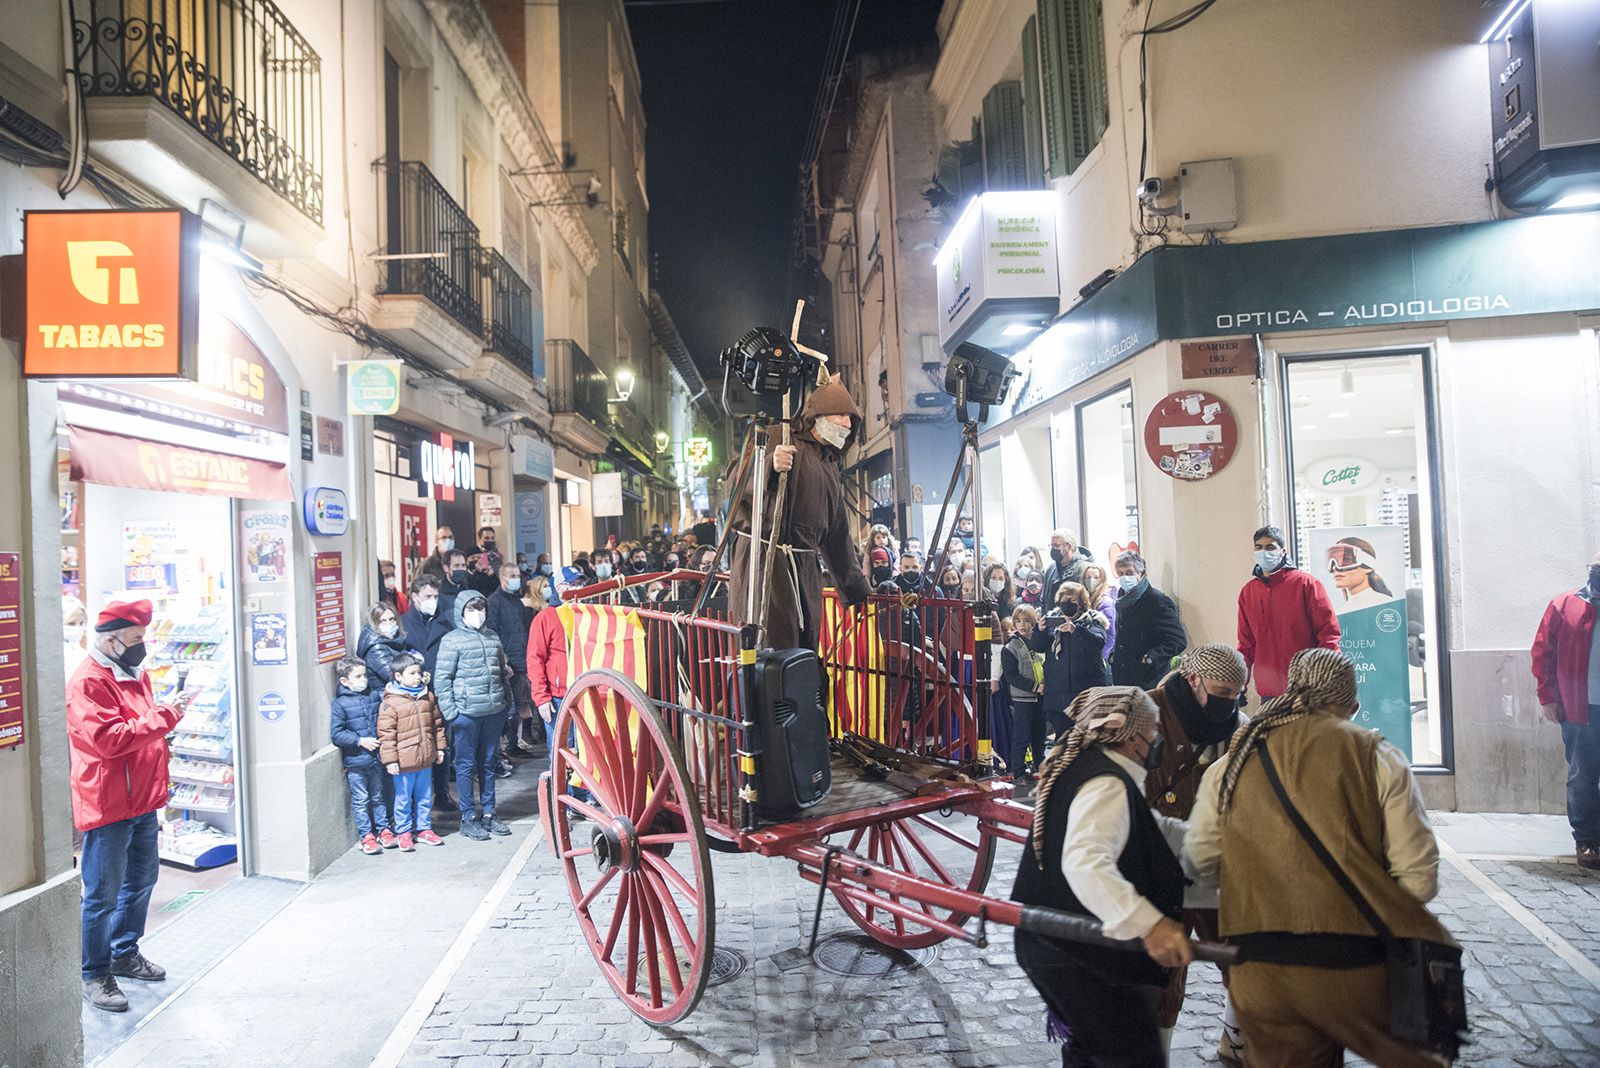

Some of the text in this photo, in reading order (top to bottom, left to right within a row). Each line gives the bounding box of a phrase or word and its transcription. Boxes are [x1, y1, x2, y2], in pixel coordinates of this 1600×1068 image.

[1216, 309, 1309, 329] OPTICA
[1343, 294, 1510, 321] AUDIOLOGIA
[39, 324, 165, 348] TABACS
[1198, 341, 1239, 352] CARRER
[1209, 354, 1228, 364] DEL
[1202, 366, 1238, 377] XERRIC
[171, 452, 249, 484] ESTANC
[421, 439, 476, 499] querol
[1322, 465, 1361, 486] Cottet
